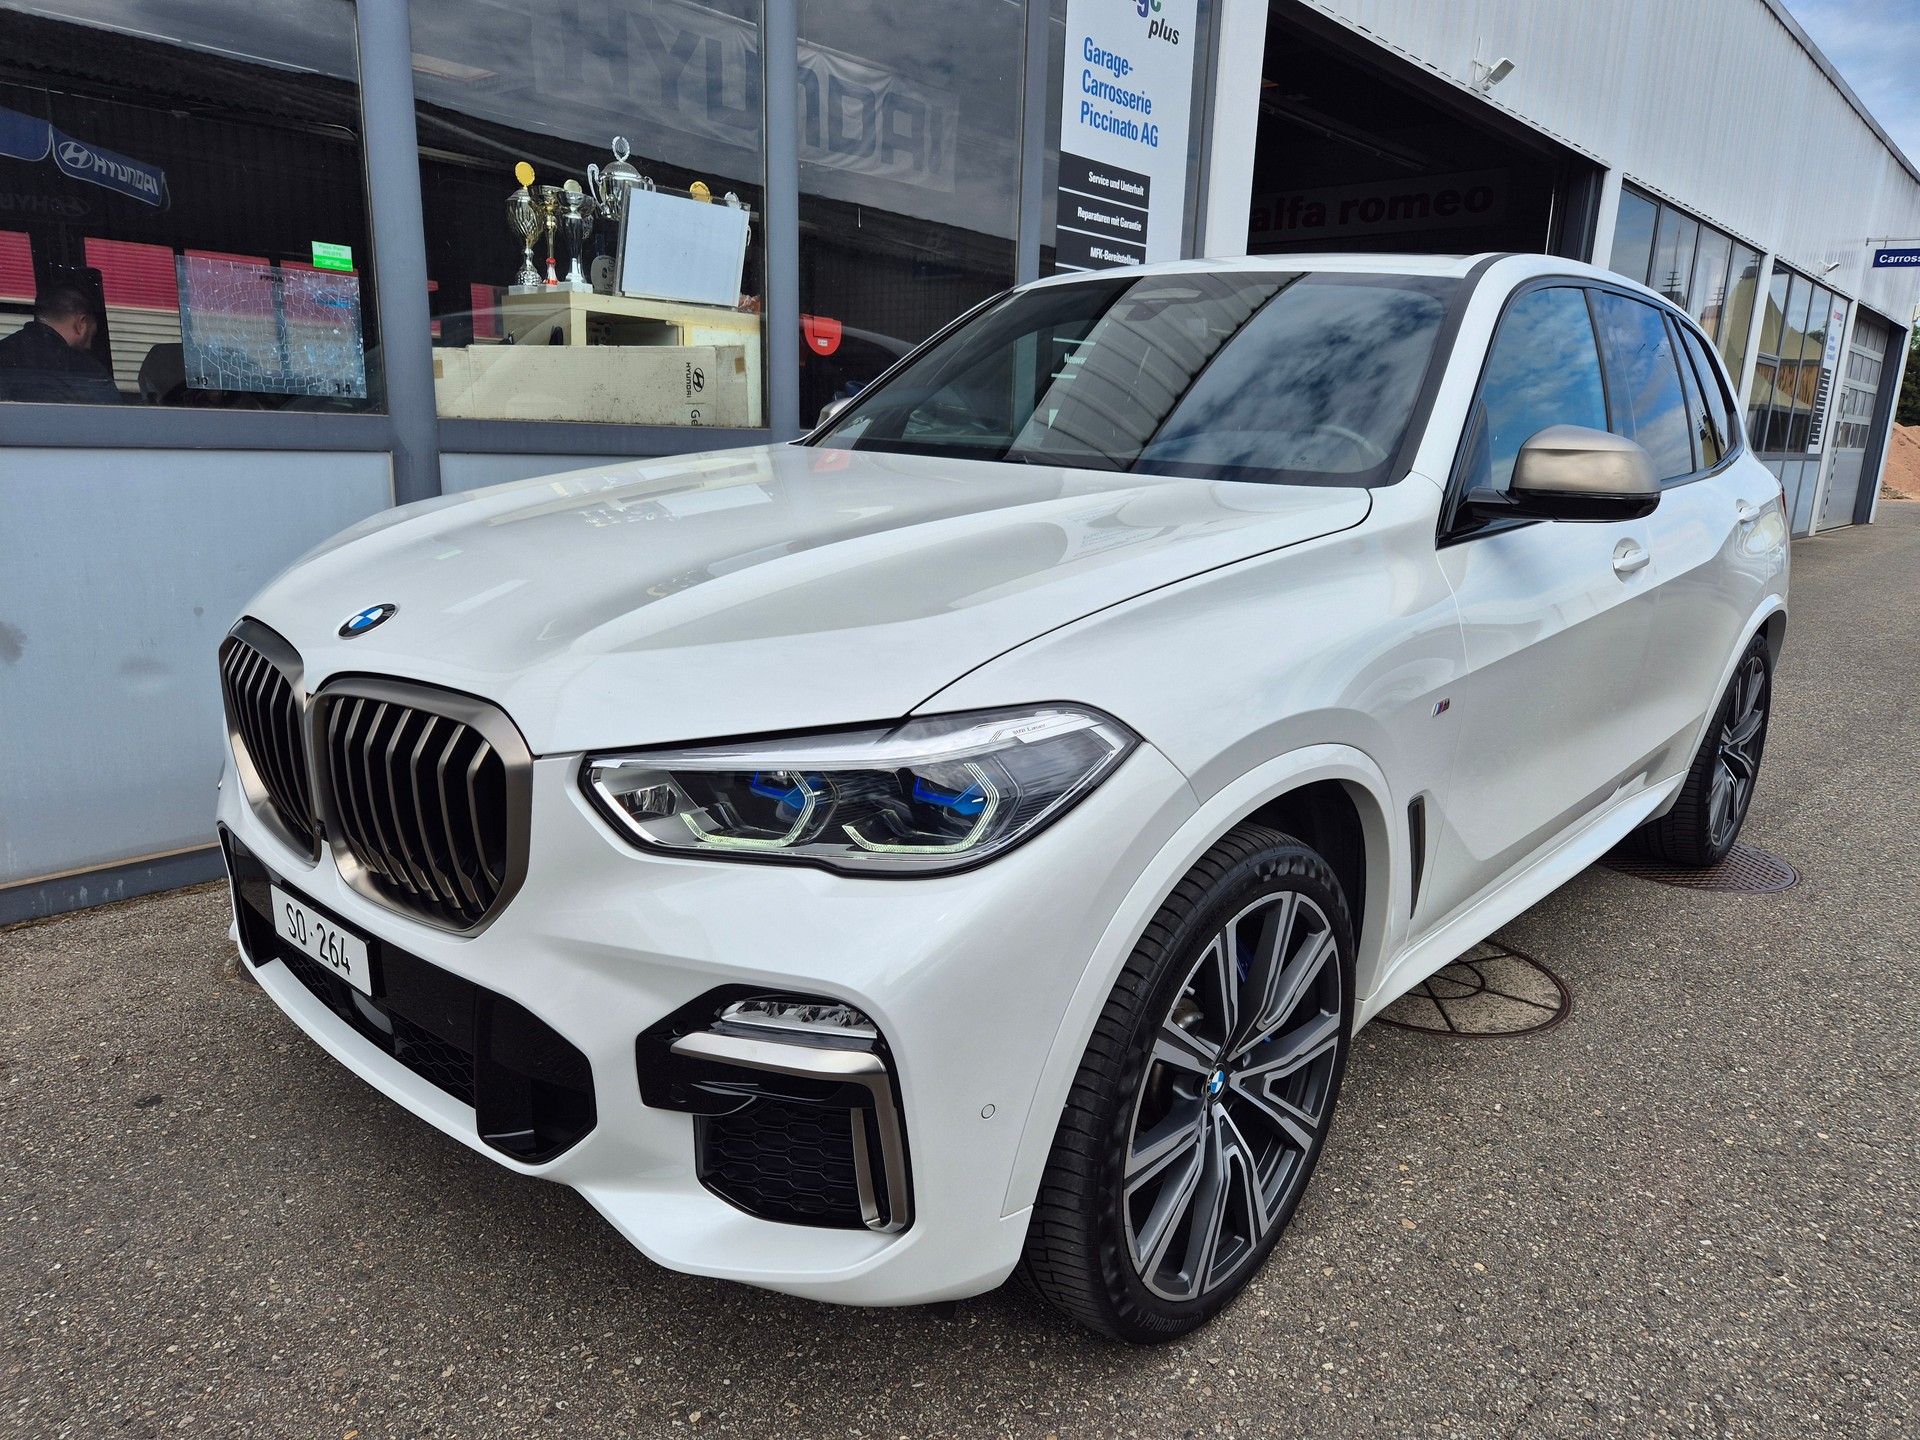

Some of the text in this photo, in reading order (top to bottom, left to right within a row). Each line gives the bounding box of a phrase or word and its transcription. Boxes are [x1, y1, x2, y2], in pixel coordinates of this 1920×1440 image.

[1148, 18, 1179, 45] plus
[1083, 36, 1133, 78] Garage-
[1082, 68, 1152, 115] Carrosserie
[1080, 100, 1158, 147] Piccinato AG
[92, 152, 159, 195] HYUNDAI
[1088, 171, 1144, 196] Service und Unterhalt
[1077, 206, 1142, 231] Reparaturen mit Garantie
[1251, 186, 1494, 232] alfa romeo
